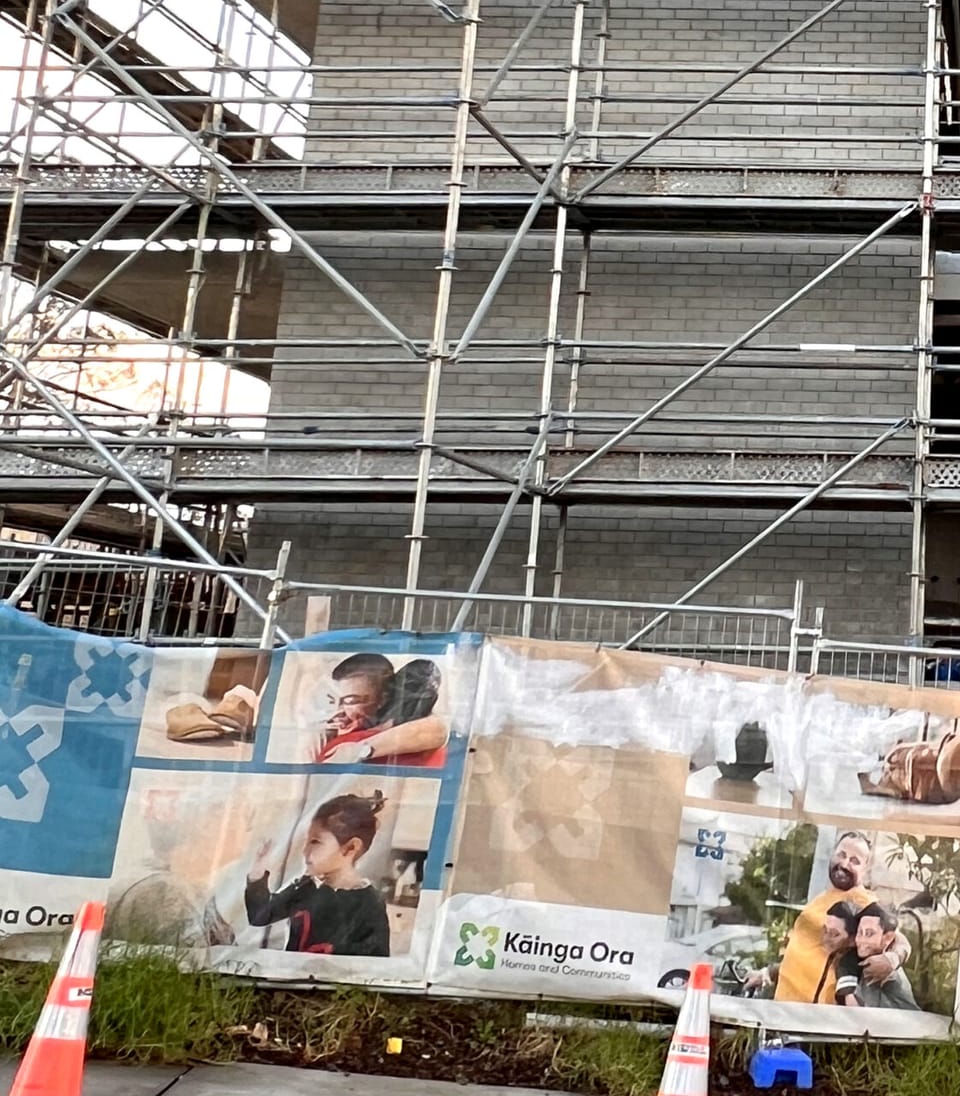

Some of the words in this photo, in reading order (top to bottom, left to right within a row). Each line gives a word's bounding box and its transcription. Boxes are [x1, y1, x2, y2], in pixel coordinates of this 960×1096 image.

[26, 906, 74, 926] Ora
[503, 931, 584, 964] Kāinga
[590, 942, 635, 965] Ora
[538, 964, 560, 974] and
